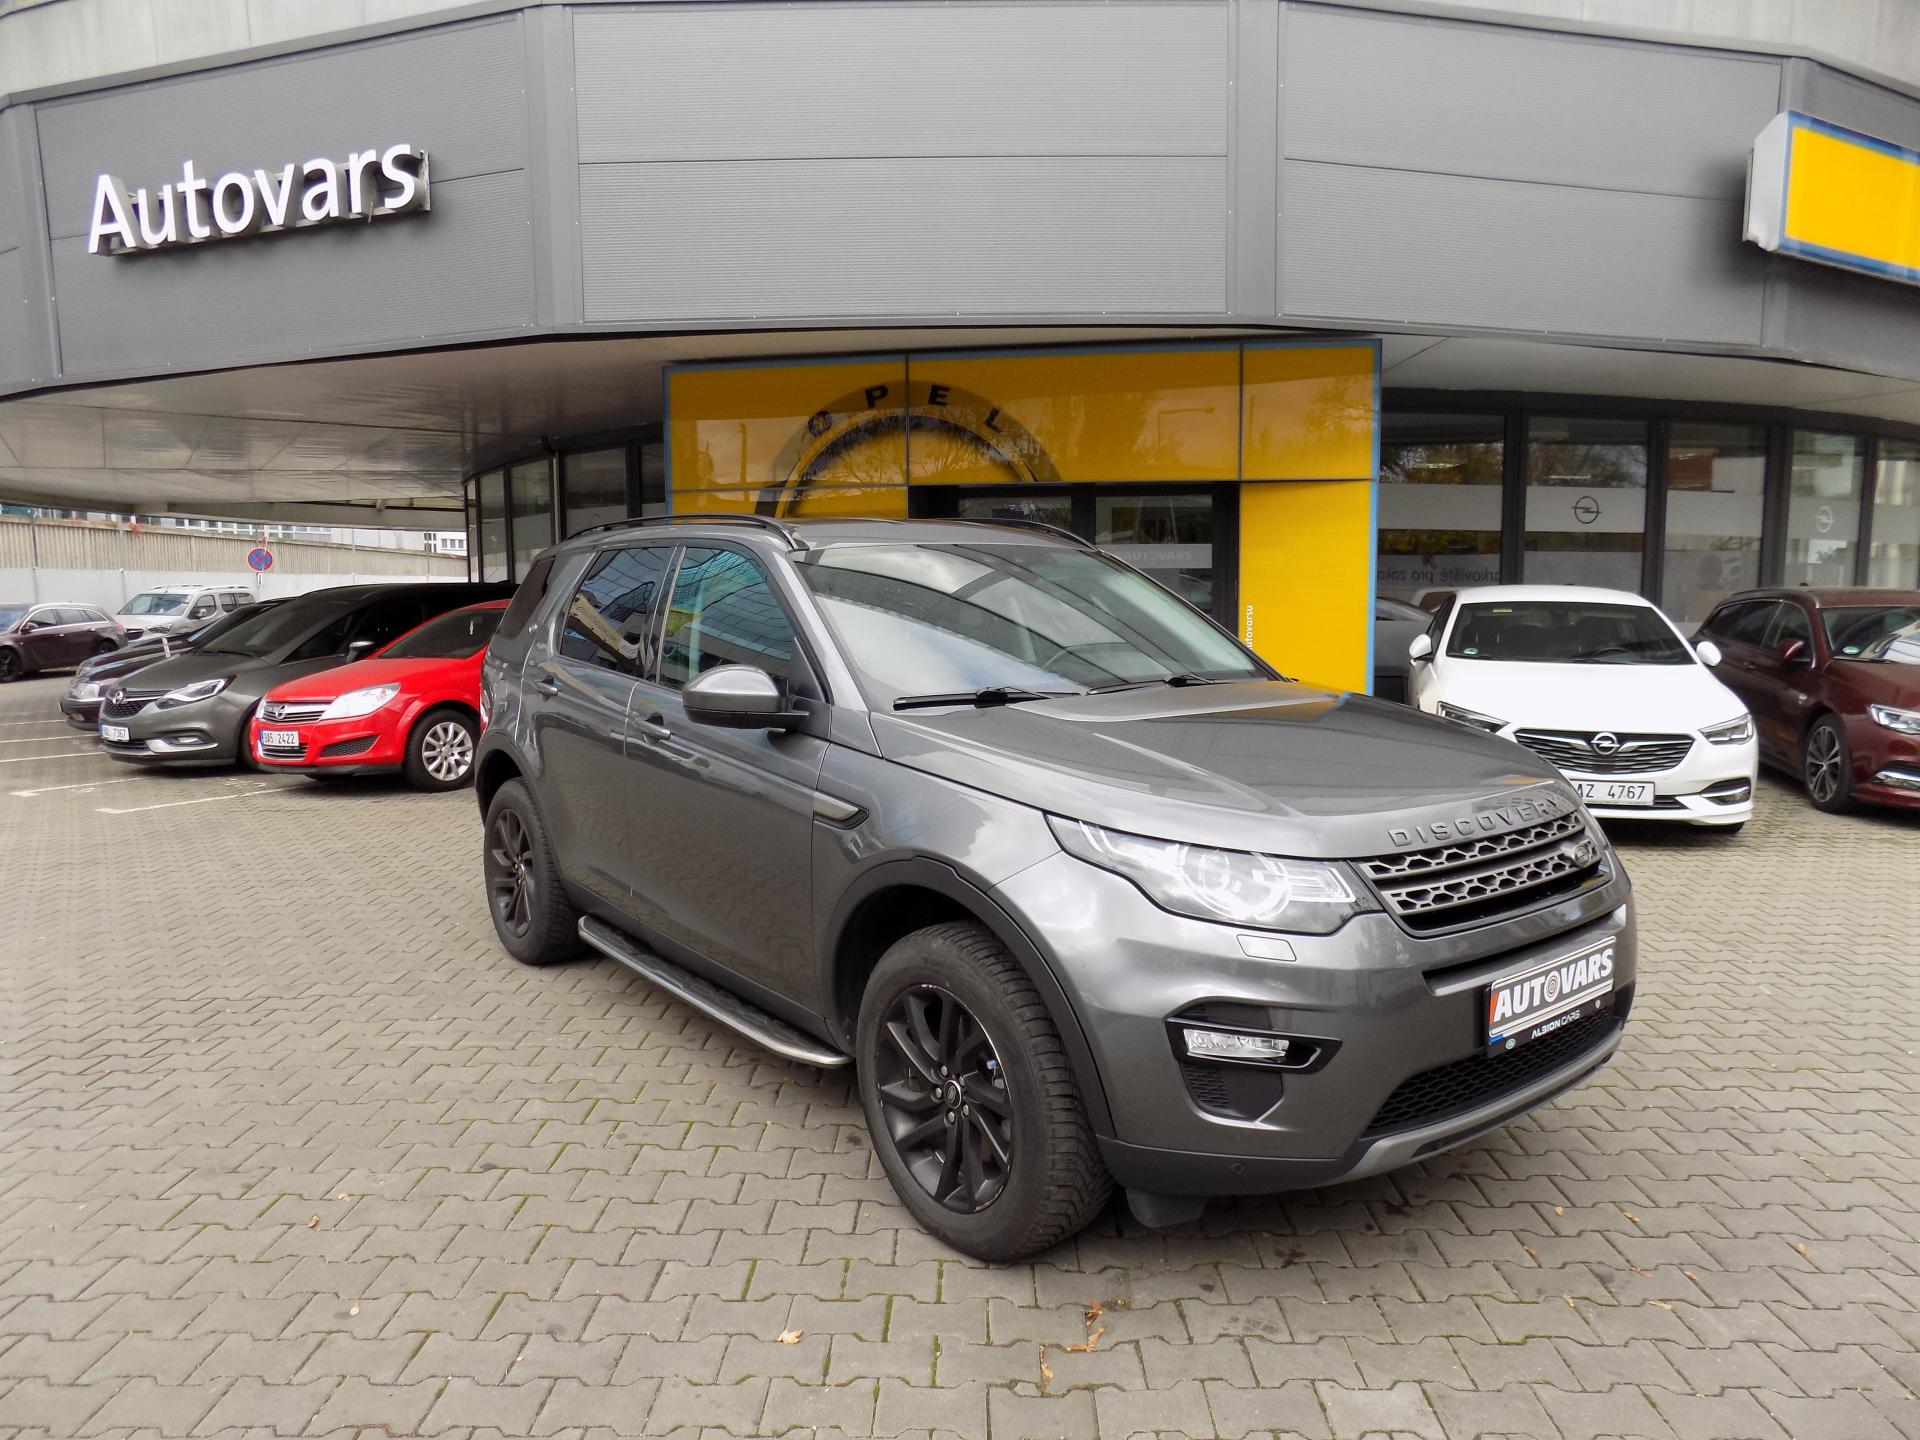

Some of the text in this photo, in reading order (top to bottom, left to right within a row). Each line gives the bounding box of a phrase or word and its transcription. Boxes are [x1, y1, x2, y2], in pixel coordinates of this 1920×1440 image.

[88, 143, 416, 255] Autovars
[807, 384, 1004, 437] OPEL
[1245, 605, 1253, 650] utovarsu
[277, 733, 295, 745] 2422
[1577, 783, 1645, 800] AZ 4767
[1388, 797, 1558, 847] DISCOVERY
[1493, 948, 1613, 1022] AUTOVARS
[1531, 1009, 1581, 1039] ALBION CARS
